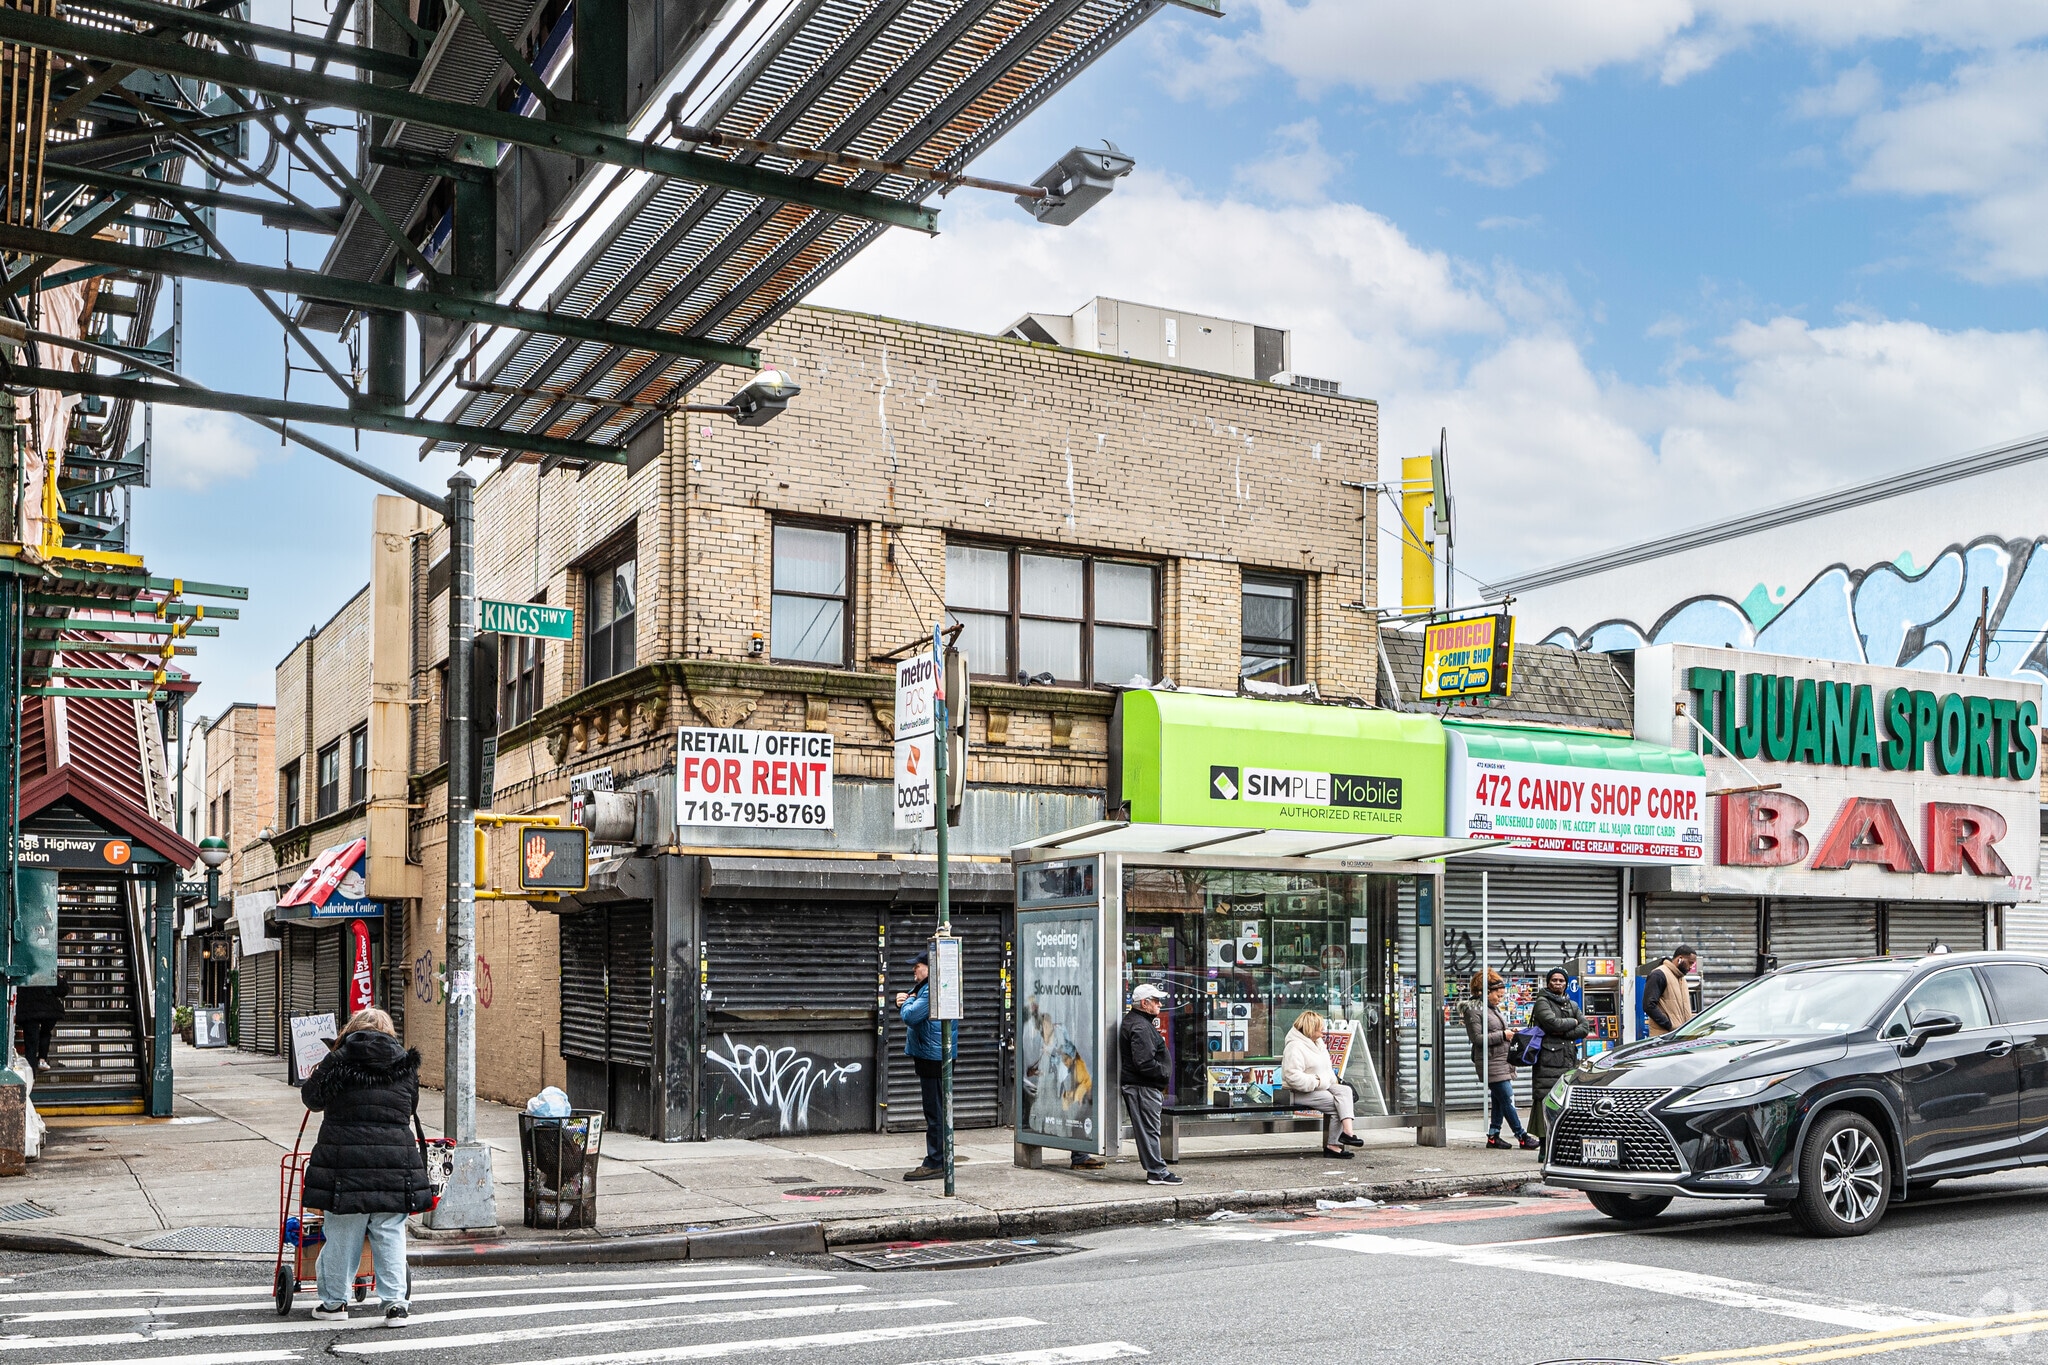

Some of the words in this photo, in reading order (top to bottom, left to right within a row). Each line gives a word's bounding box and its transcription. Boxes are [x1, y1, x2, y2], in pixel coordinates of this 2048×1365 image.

[485, 603, 540, 633] KINGS
[540, 609, 567, 624] HWY
[1428, 622, 1492, 652] TOBACCO
[1448, 651, 1471, 667] CANDY
[1472, 647, 1492, 664] SHOP
[901, 658, 932, 688] metro
[1441, 674, 1459, 687] OPEN
[1459, 667, 1470, 691] 7
[1467, 671, 1486, 685] DAYS
[906, 687, 925, 718] PCS
[899, 719, 918, 732] Authorized
[918, 716, 931, 727] Dealer
[1688, 666, 1879, 768] TIJUANA
[1881, 686, 2038, 781] SPORTS
[680, 731, 749, 754] RETAIL
[765, 735, 832, 758] OFFICE
[684, 757, 742, 794] FOR
[752, 760, 827, 797] RENT
[898, 778, 930, 808] boost
[1247, 774, 1327, 800] SIMPLE
[1333, 777, 1399, 804] Mobile
[1476, 773, 1511, 808] 472
[1518, 777, 1586, 813] CANDY
[1590, 782, 1642, 816] SHOP
[1647, 787, 1699, 821] CORP.
[684, 800, 826, 825] 718-795-8769
[1279, 807, 1350, 820] AUTHORIZED
[1353, 811, 1402, 823] RETAILER
[1474, 813, 1488, 822] ATM
[1469, 820, 1492, 830] INSIDE
[1495, 814, 1534, 828] HOUSEHOLD
[1535, 818, 1557, 831] GOODS
[1562, 820, 1572, 832] WE
[1573, 821, 1597, 833] ACCEPT
[1598, 822, 1610, 834] ALL
[1611, 823, 1631, 837] MAJOR
[1633, 824, 1655, 836] CREDIT
[1656, 825, 1676, 838] CARDS
[1685, 827, 1699, 836] ATM
[1720, 791, 2012, 877] BAR
[44, 839, 96, 852] Highway
[1682, 833, 1703, 843] INSIDE
[113, 845, 125, 860] F
[1538, 839, 1566, 850] CANDY
[1572, 840, 1586, 851] ICE
[1587, 841, 1615, 853] CREAM
[1621, 843, 1645, 854] CHIPS
[1650, 845, 1679, 856] COFFEE
[1684, 847, 1700, 857] TEA
[2008, 875, 2033, 890] 472
[355, 901, 377, 913] Center
[1232, 902, 1264, 912] boost
[1036, 929, 1078, 950] Speeding
[361, 935, 370, 971] verizon
[1034, 952, 1056, 968] ruins
[1056, 951, 1080, 968] lives.
[356, 961, 364, 973] by
[1033, 979, 1054, 996] Slow
[1054, 979, 1082, 996] down.
[292, 1014, 333, 1029] SAMSUNG
[296, 1029, 316, 1039] Galaxy
[1253, 1069, 1274, 1085] WE
